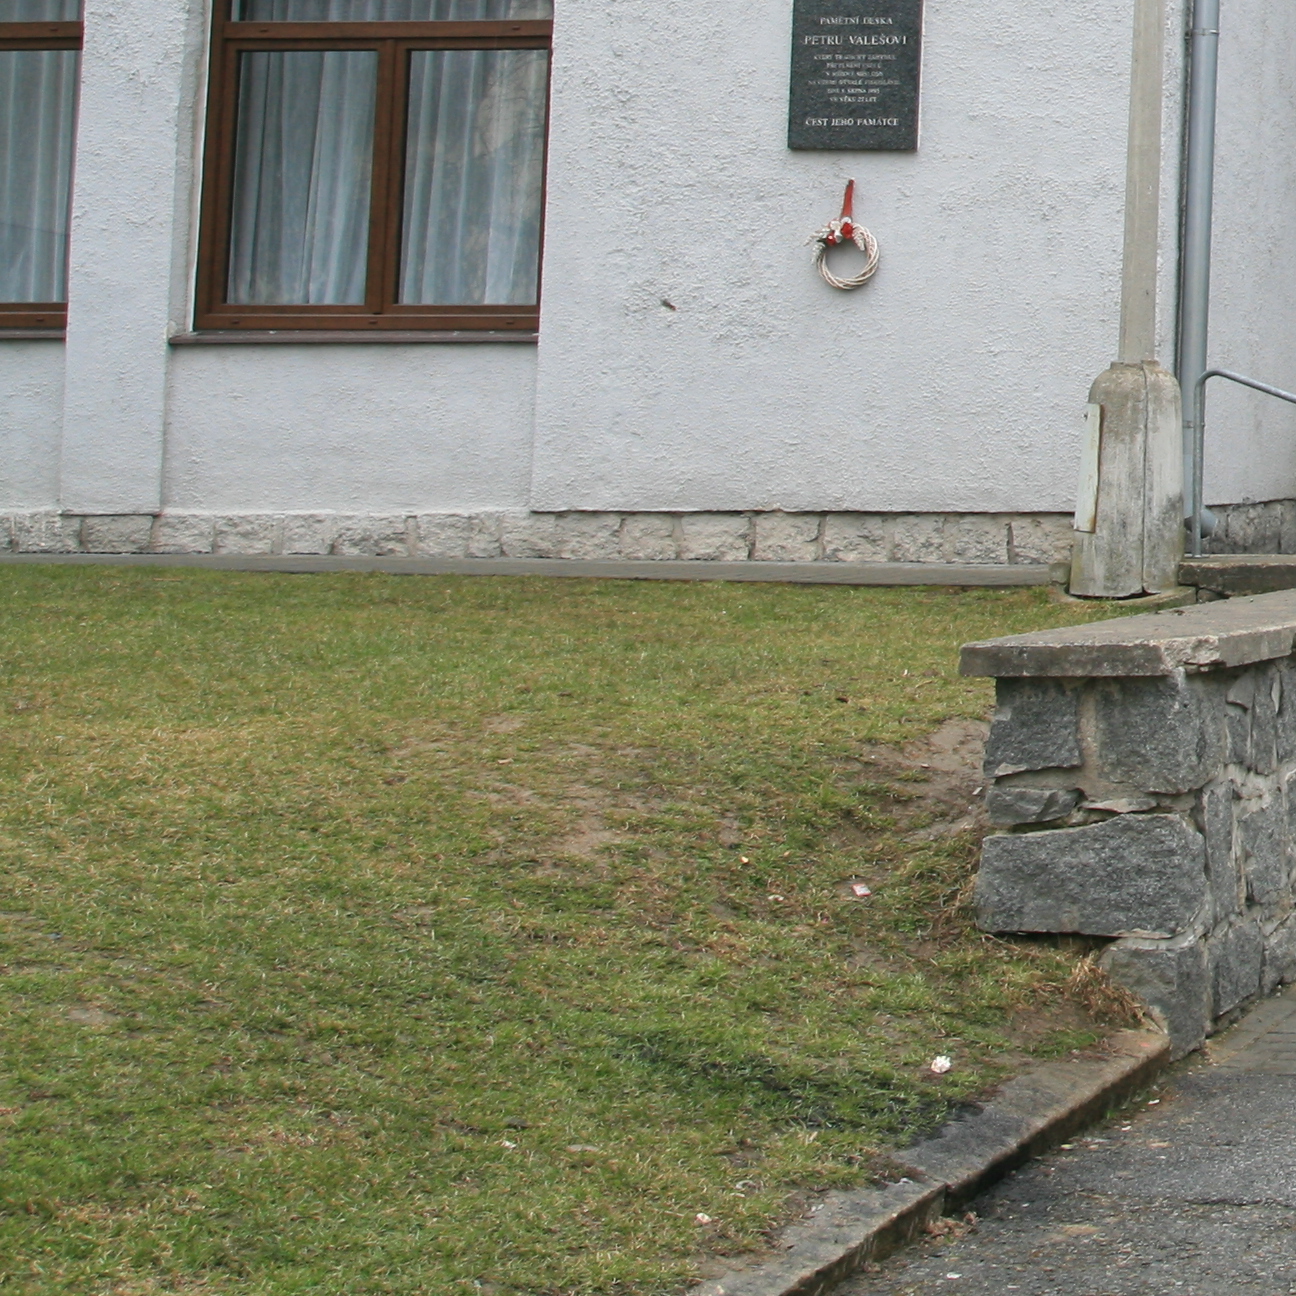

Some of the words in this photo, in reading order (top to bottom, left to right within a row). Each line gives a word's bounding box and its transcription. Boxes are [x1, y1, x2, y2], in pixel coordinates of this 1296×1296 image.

[804, 35, 843, 45] PETRU
[849, 33, 907, 45] VALEŠOVI
[805, 116, 828, 126] ČEST
[831, 117, 854, 126] JEHO
[857, 116, 898, 126] PAMÁTCE
